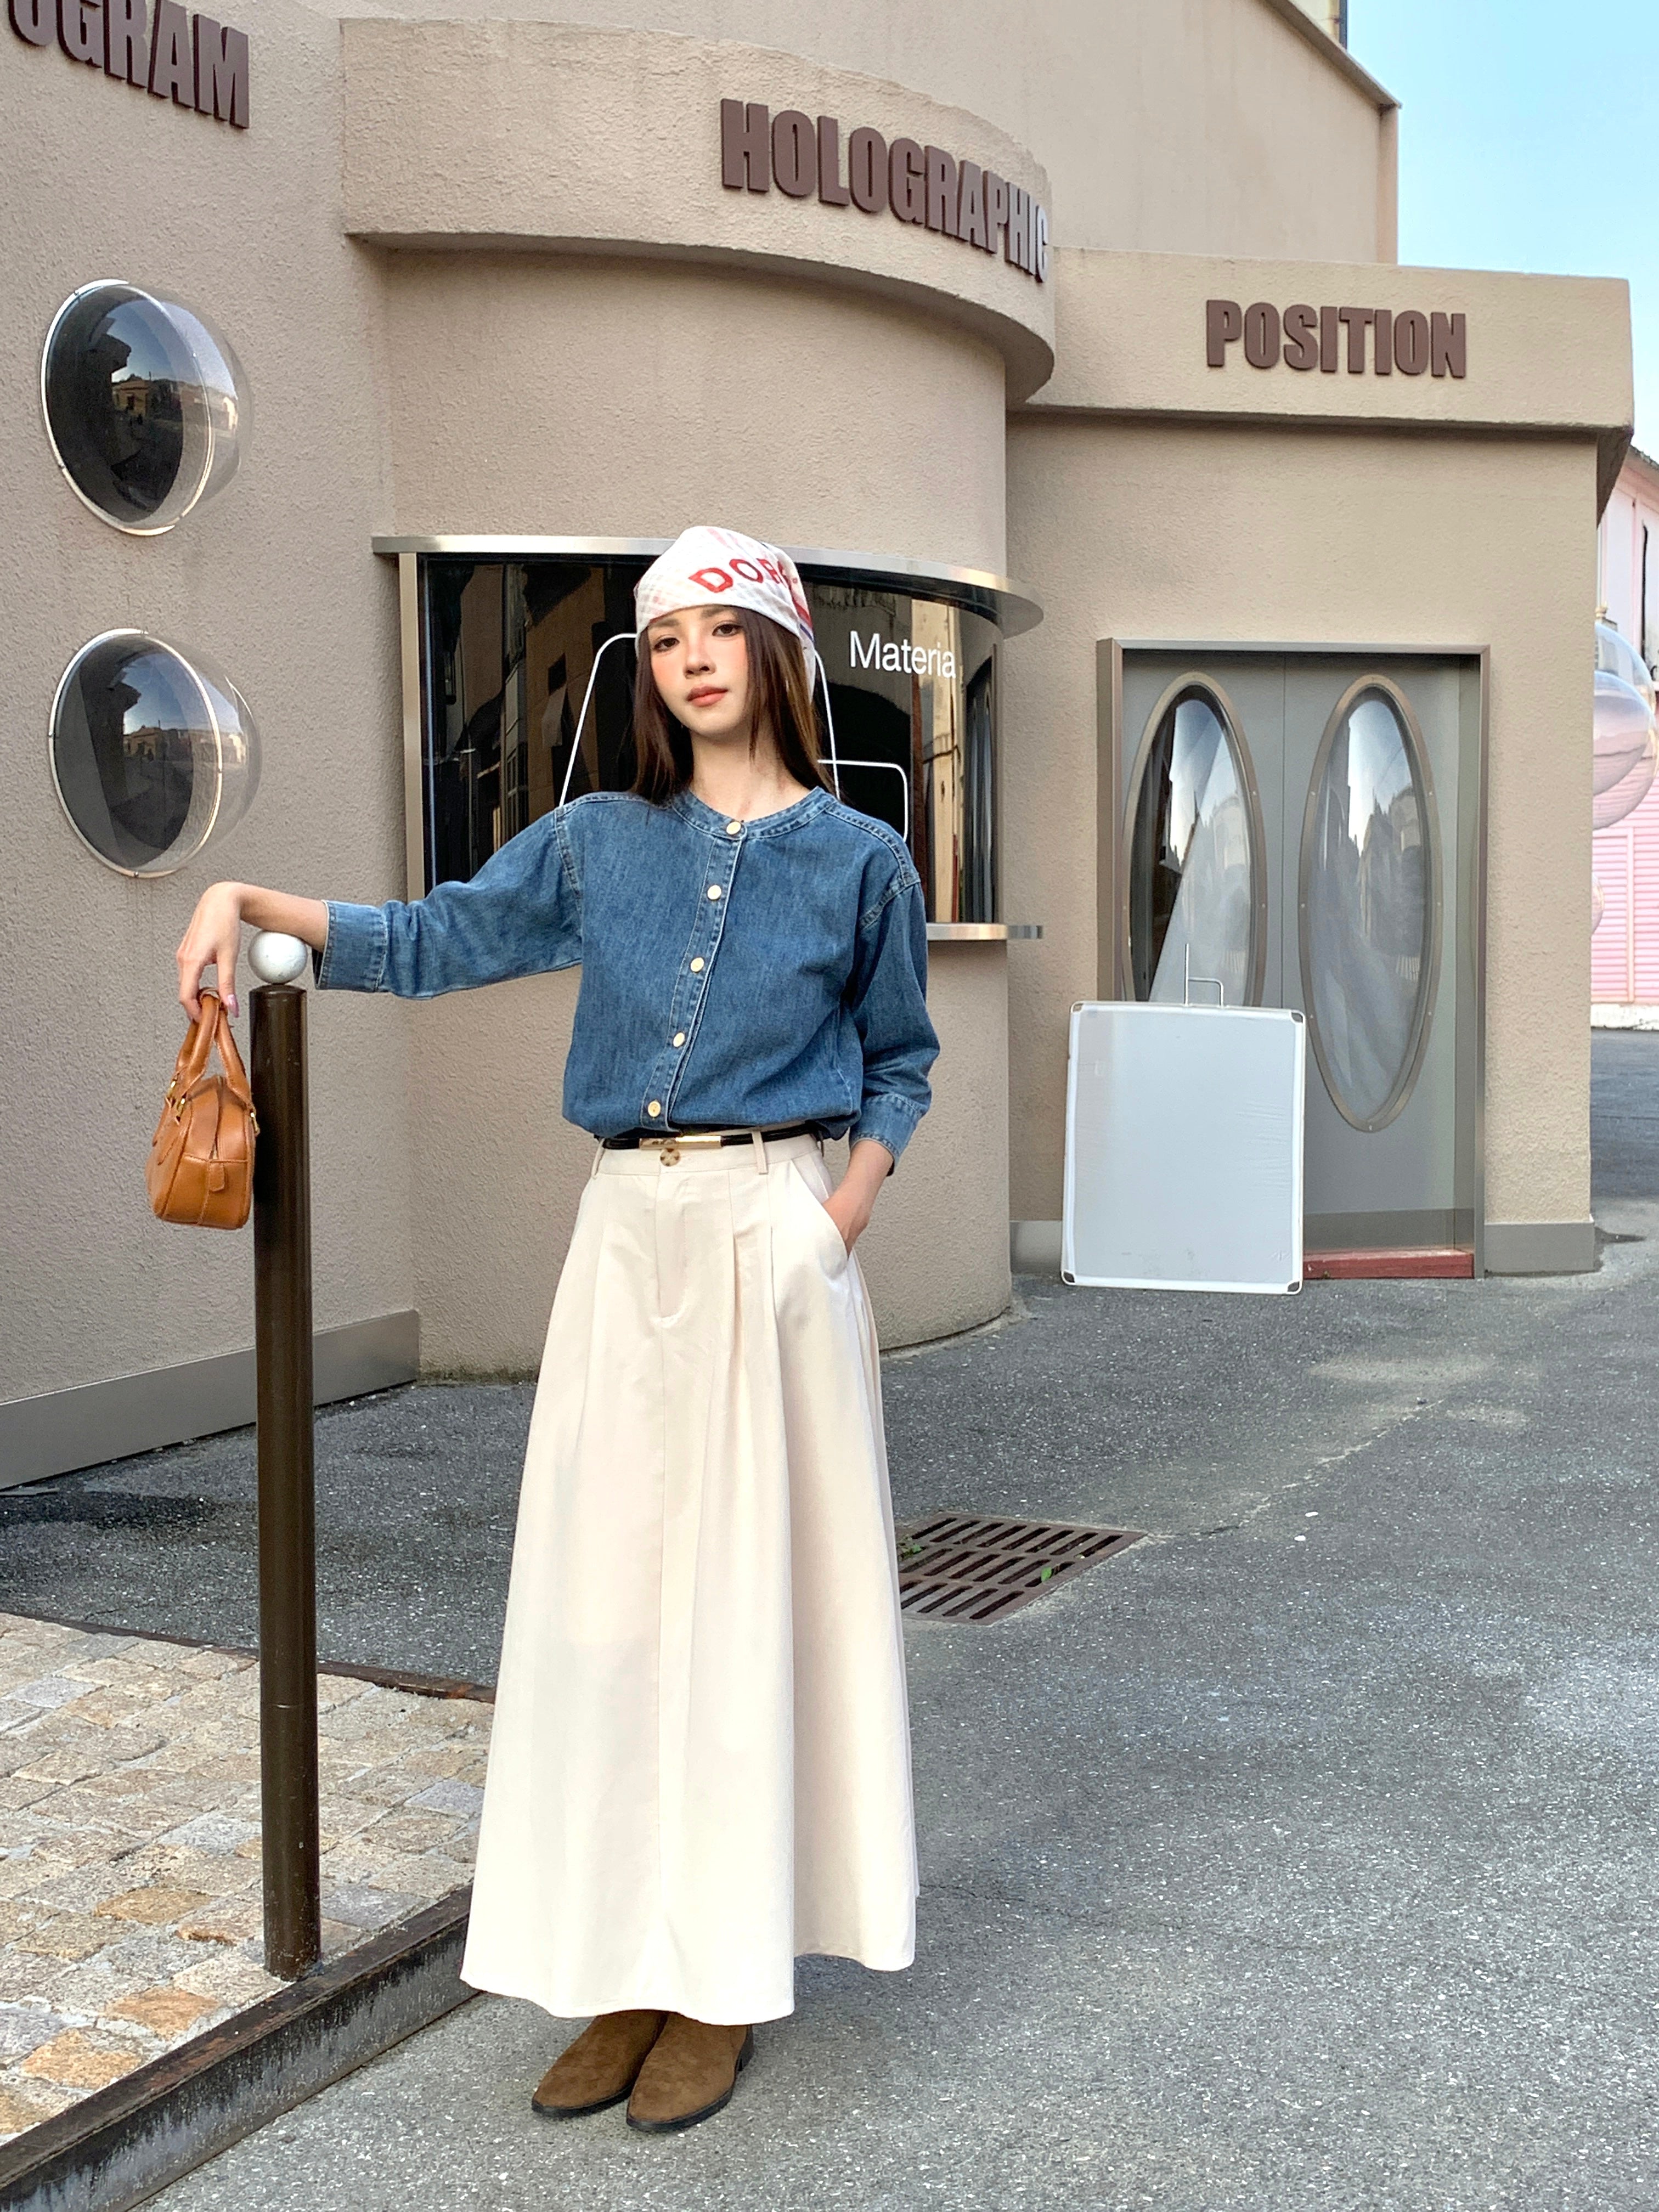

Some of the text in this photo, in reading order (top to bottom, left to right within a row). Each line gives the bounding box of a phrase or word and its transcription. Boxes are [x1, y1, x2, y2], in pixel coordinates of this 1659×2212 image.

[720, 98, 1049, 283] HOLOGRAPHIC
[1206, 300, 1466, 378] POSITION
[850, 631, 956, 679] Materia
